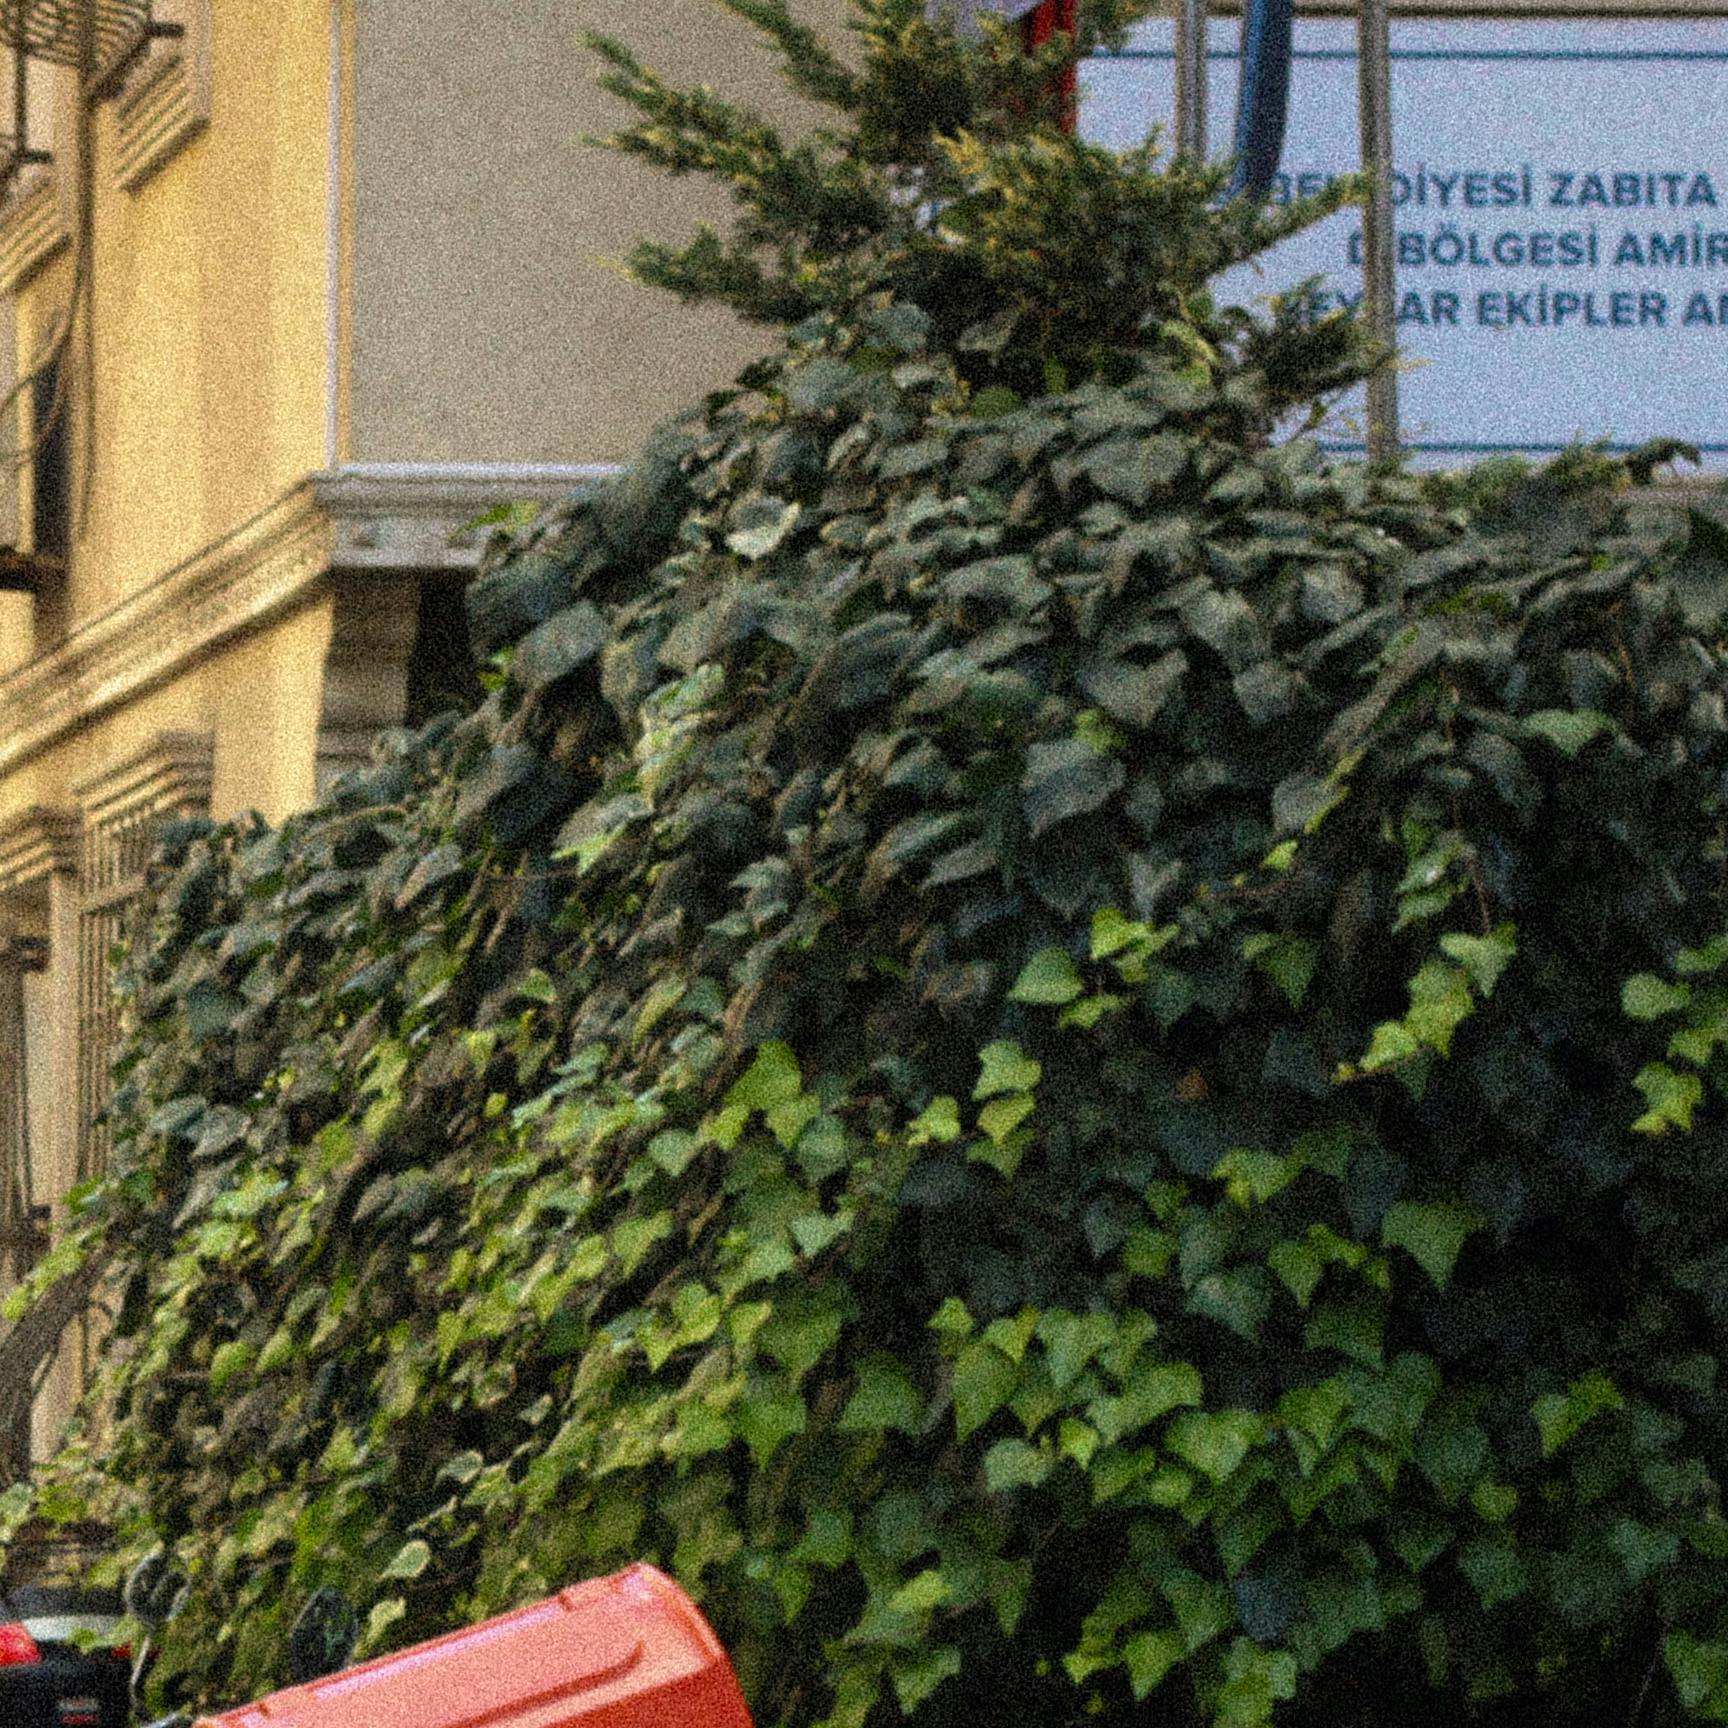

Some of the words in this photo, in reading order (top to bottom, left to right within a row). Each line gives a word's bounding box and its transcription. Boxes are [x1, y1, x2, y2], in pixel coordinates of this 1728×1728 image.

[1548, 170, 1718, 208] ZABITA
[1398, 222, 1600, 268] BÖLGESİ
[1476, 283, 1667, 327] EKİPLER
